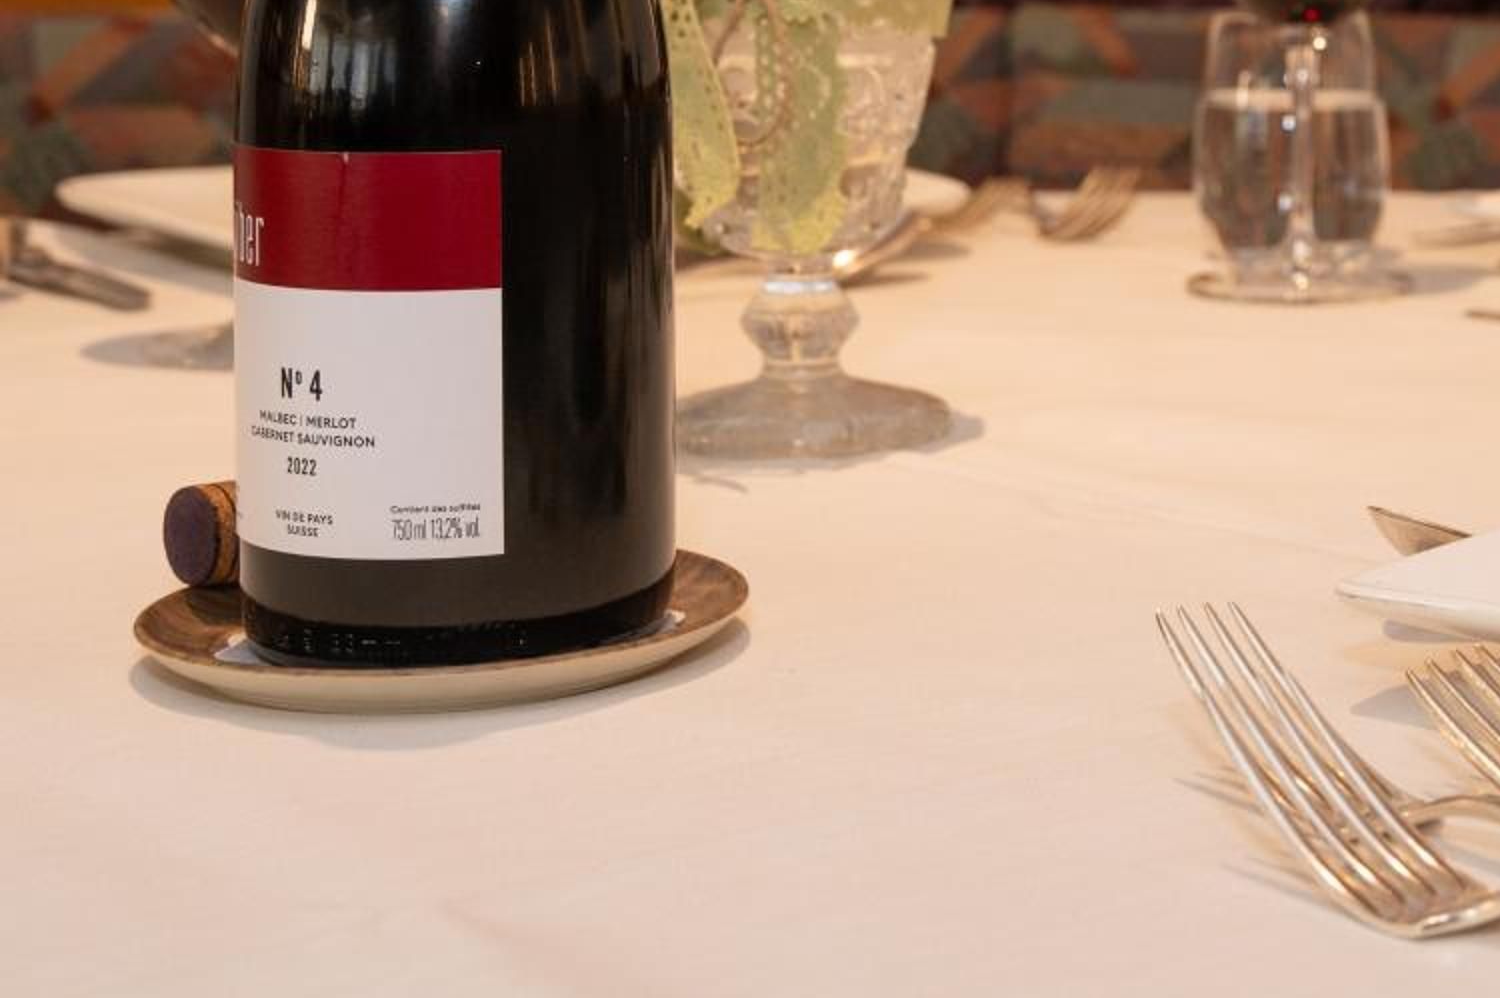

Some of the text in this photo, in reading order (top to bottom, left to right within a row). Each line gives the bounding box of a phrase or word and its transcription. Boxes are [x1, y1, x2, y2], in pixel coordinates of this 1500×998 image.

[309, 370, 323, 401] 4
[259, 410, 297, 426] MALBEC
[306, 415, 357, 429] MERLOT
[251, 425, 376, 448] CABERNET SAUVIGNON
[287, 456, 317, 476] 2022
[275, 509, 334, 526] VIN DE PAYS
[286, 524, 319, 538] SUISSE
